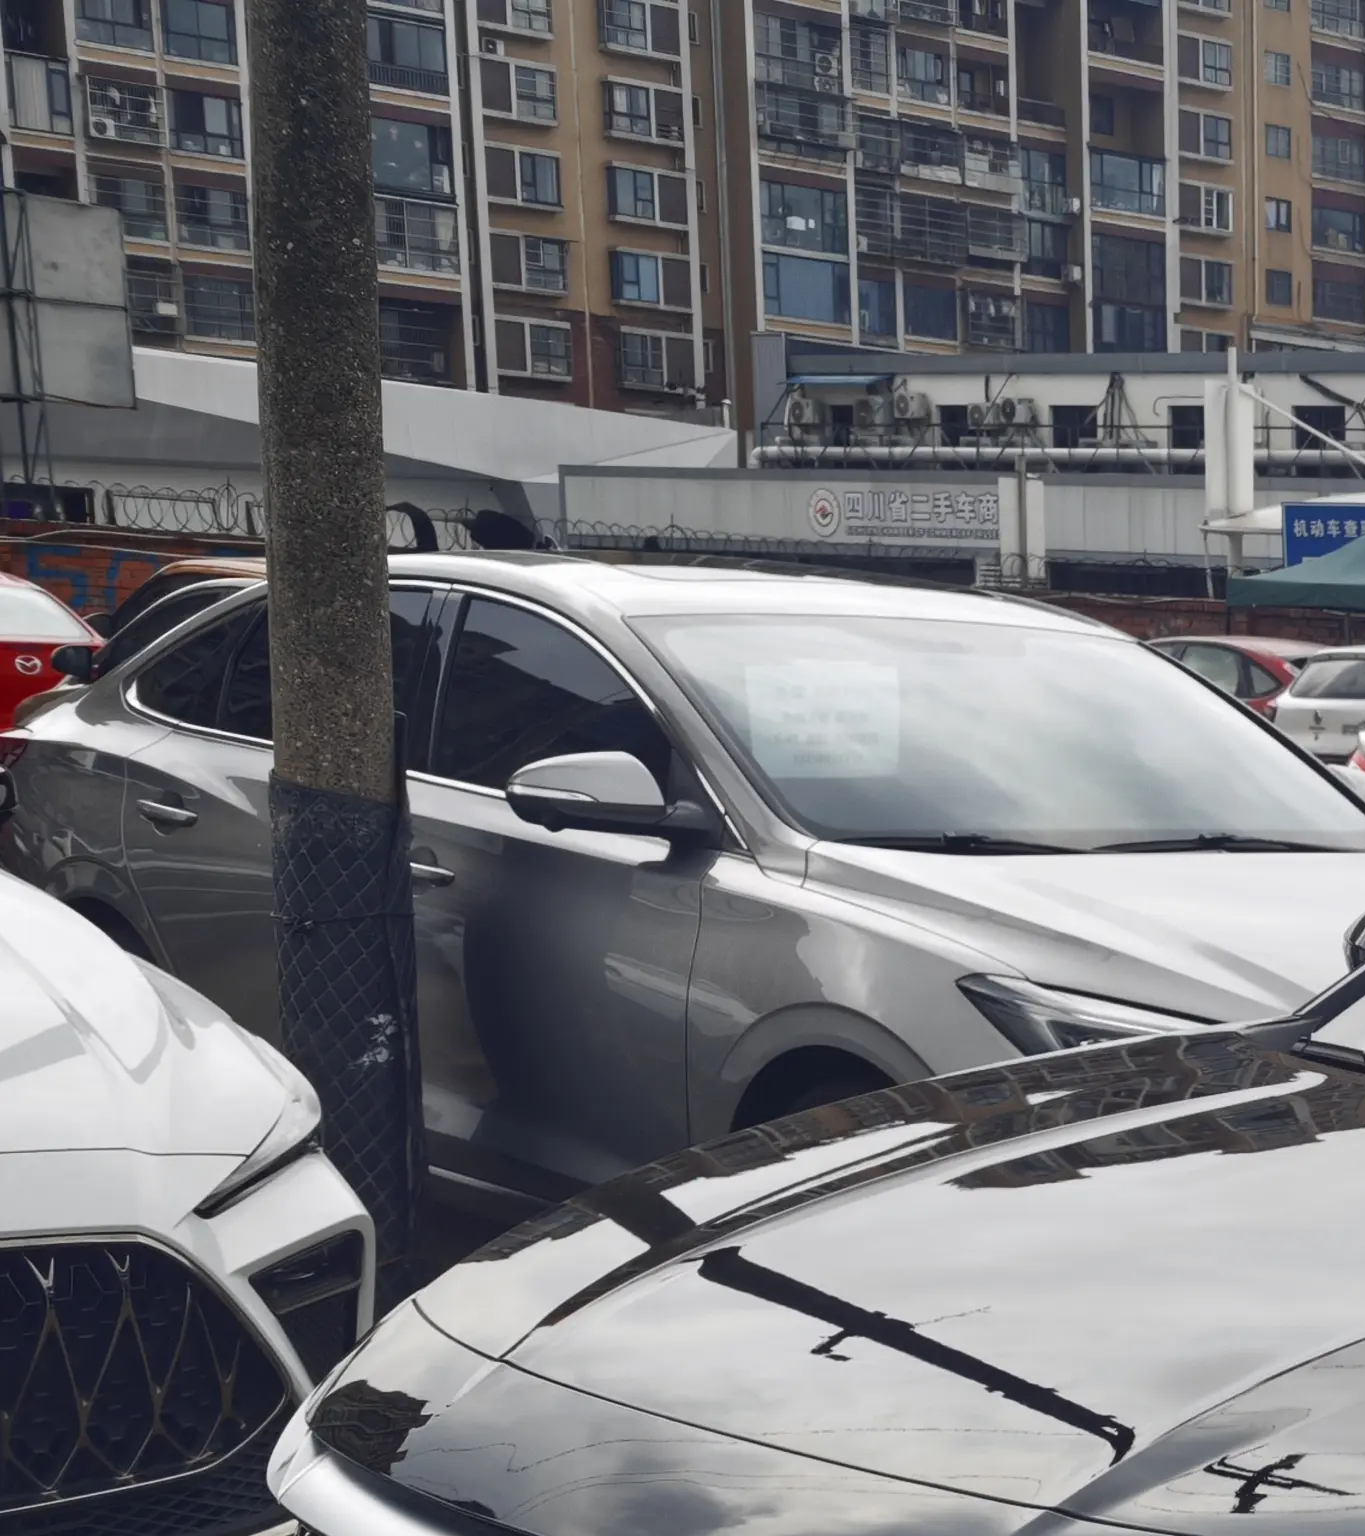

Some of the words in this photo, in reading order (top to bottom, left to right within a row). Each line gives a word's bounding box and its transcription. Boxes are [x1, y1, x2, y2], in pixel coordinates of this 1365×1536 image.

[844, 491, 999, 525] 四川省二手车商
